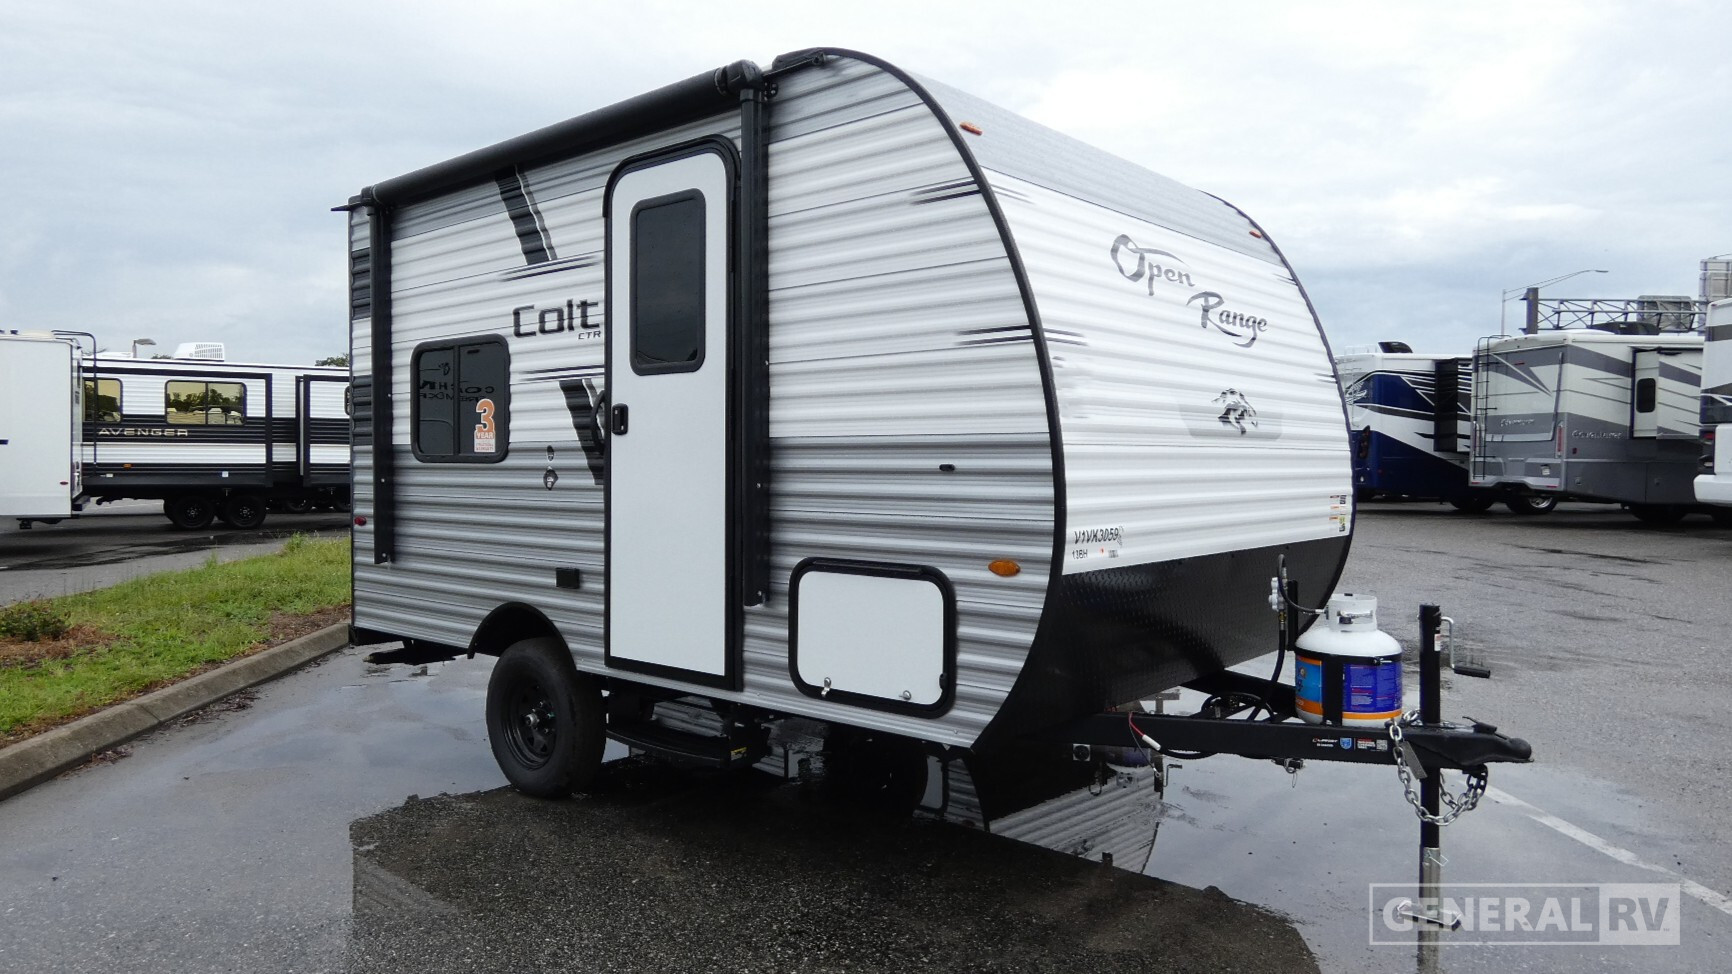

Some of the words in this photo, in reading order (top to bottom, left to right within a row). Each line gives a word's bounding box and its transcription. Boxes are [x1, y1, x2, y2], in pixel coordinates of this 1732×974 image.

[1110, 234, 1195, 296] Open
[512, 298, 600, 338] Colt
[1186, 291, 1267, 348] Range
[577, 331, 601, 340] CTR
[98, 427, 189, 437] AVENGER
[475, 398, 495, 432] 3
[476, 431, 494, 439] YEAR
